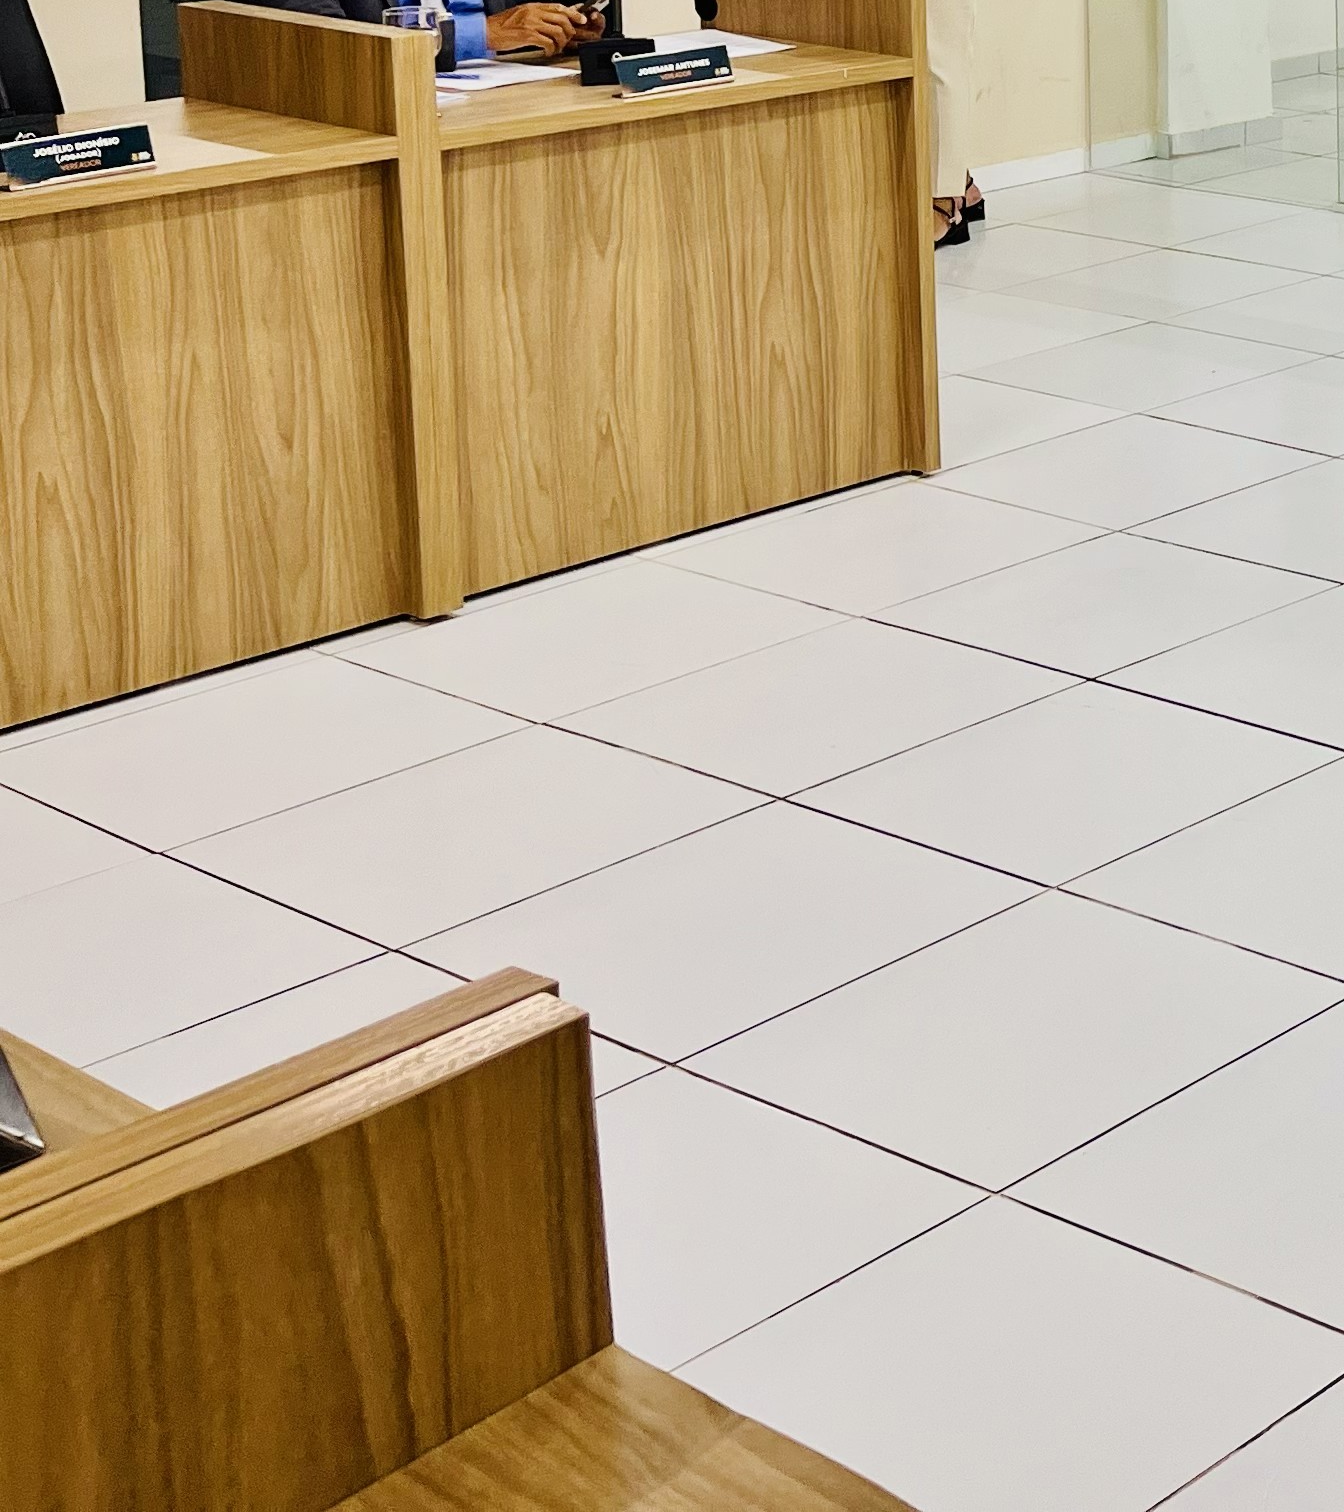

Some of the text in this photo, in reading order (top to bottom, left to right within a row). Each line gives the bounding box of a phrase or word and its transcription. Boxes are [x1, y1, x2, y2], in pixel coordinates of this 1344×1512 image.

[675, 58, 711, 70] ANTUNES
[33, 136, 120, 158] JOSÉLIO DIONÍSIO
